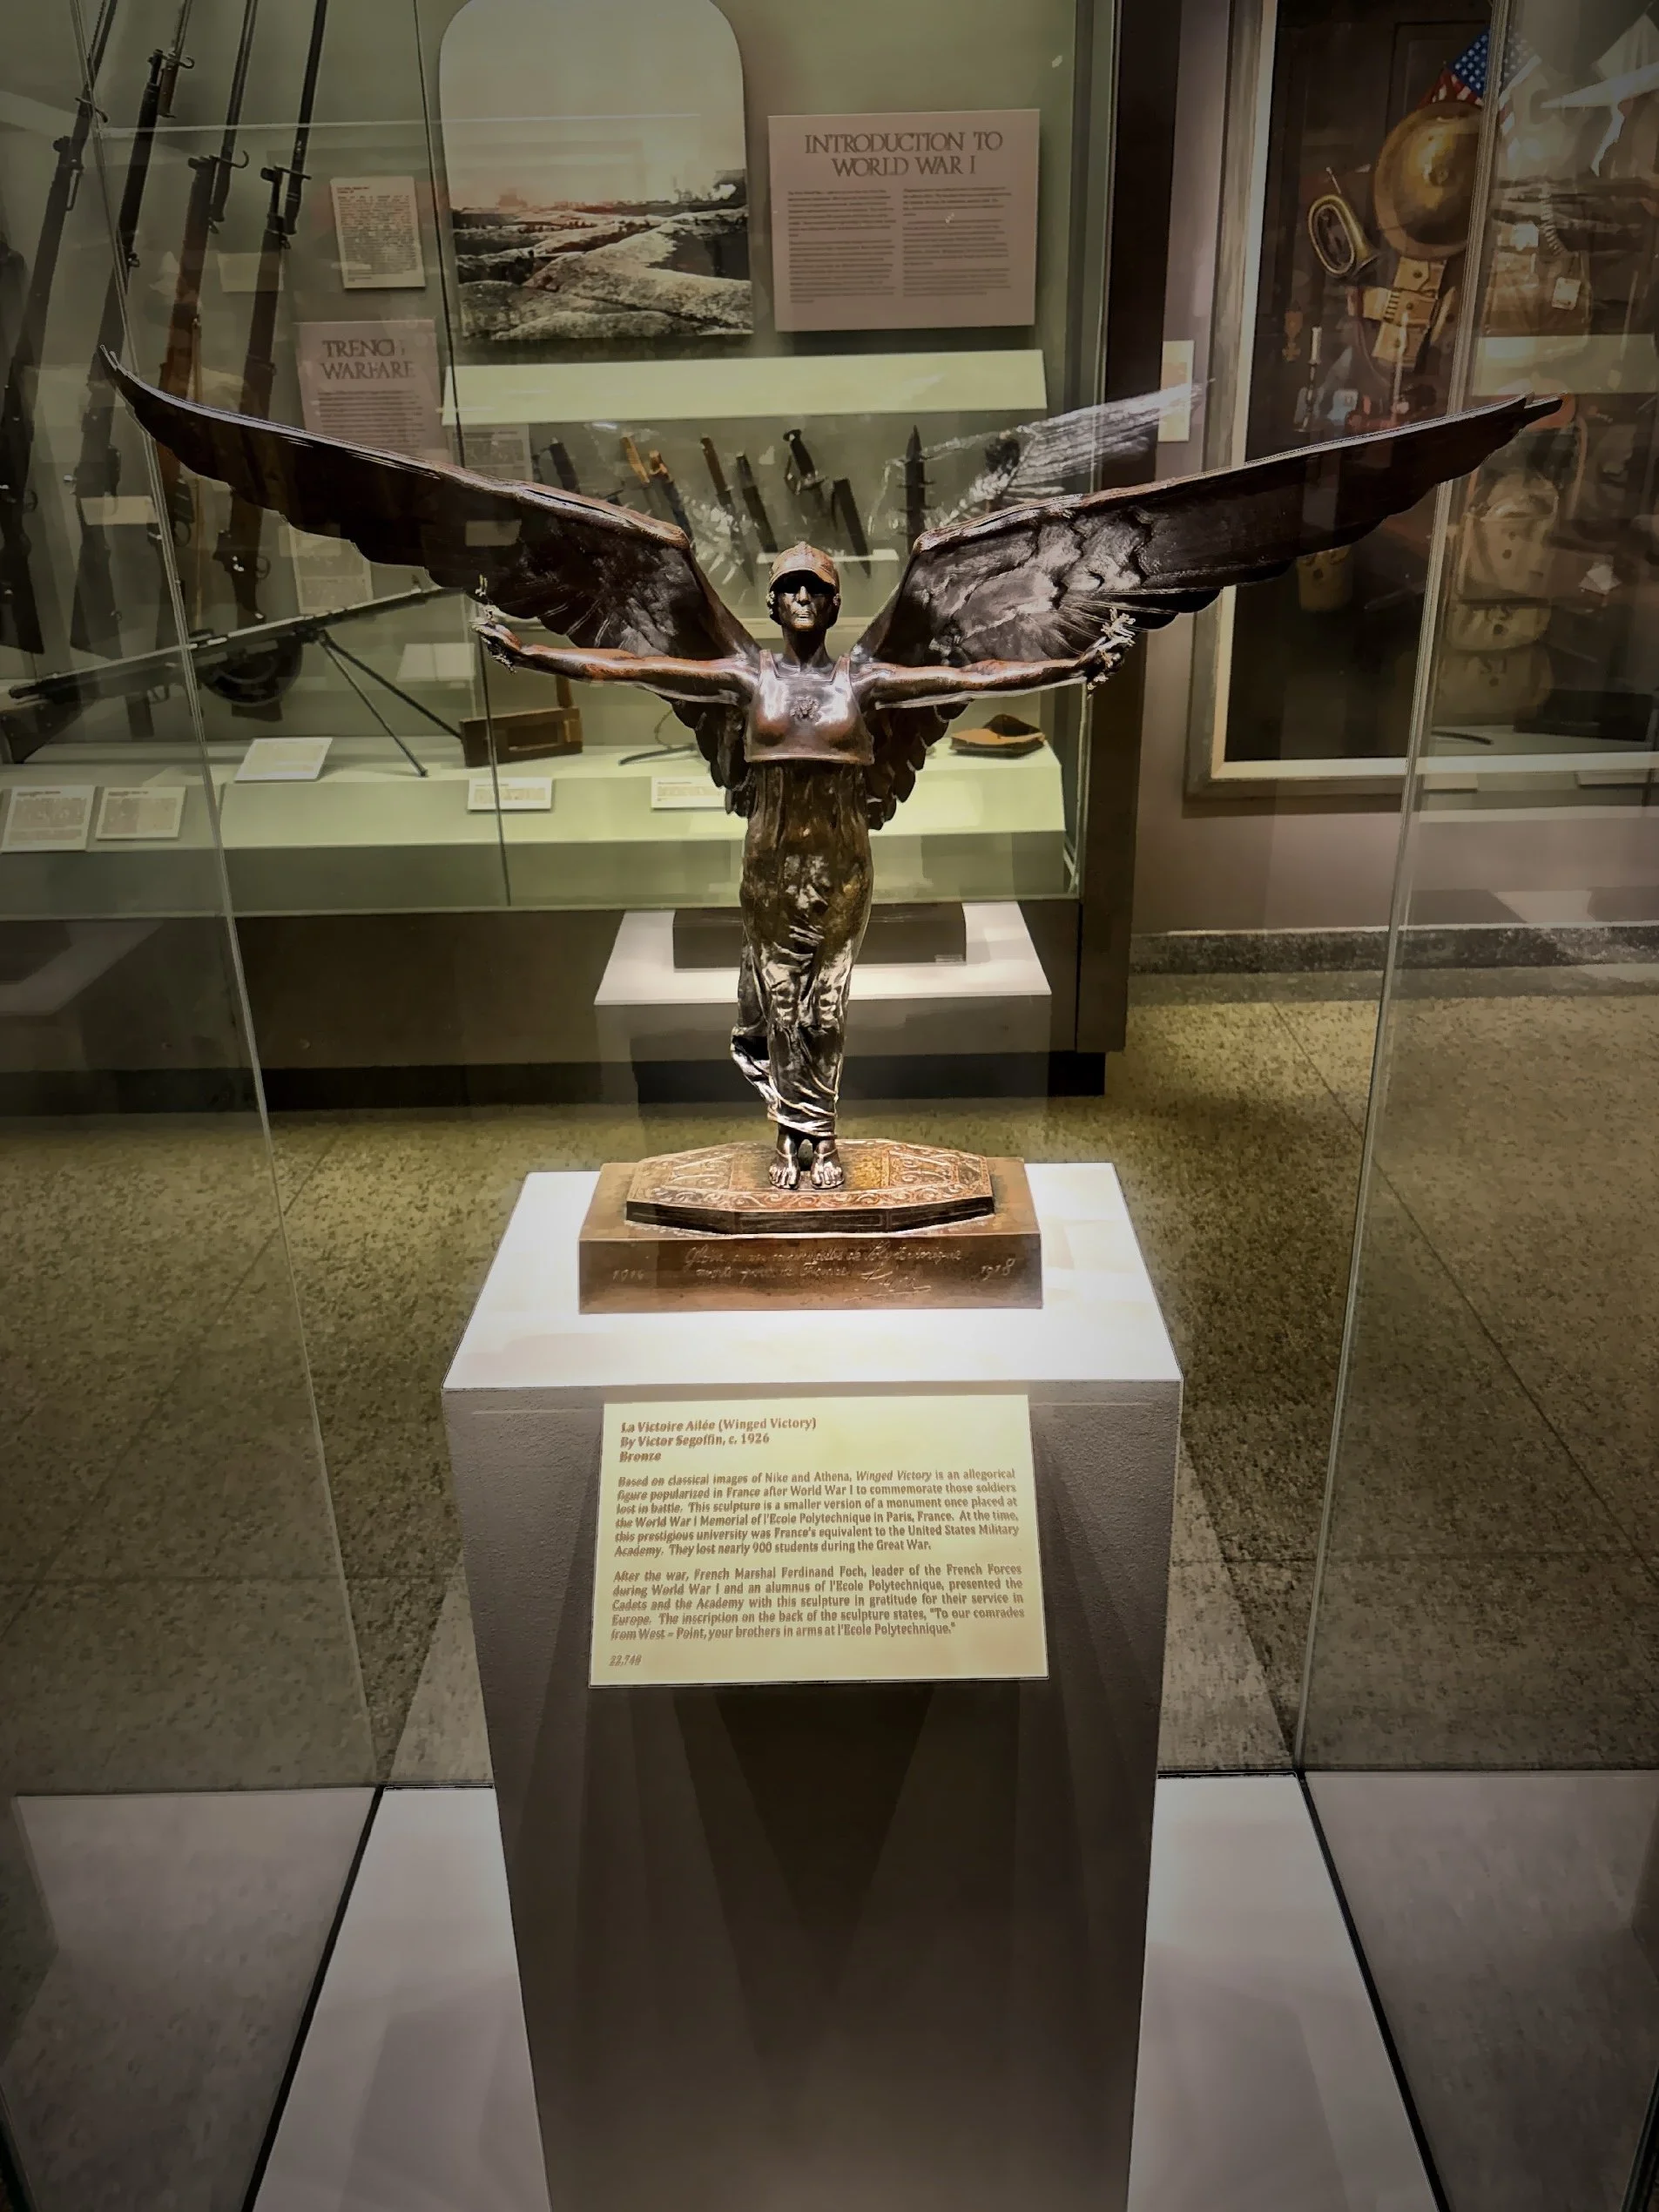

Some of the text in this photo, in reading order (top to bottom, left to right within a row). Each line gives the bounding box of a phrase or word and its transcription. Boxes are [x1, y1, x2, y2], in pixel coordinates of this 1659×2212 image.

[805, 131, 1003, 154] INTRODUCTION TO
[831, 155, 976, 177] WORLD WAR I
[320, 361, 416, 380] WARFARE
[620, 1421, 636, 1433] La
[637, 1420, 685, 1433] Victoire
[718, 1418, 767, 1432] (Winged
[769, 1417, 817, 1431] Victory)
[619, 1433, 770, 1449] By Victor Segoffin, c. 1926
[618, 1450, 662, 1462] Bronze
[617, 1467, 1015, 1487] Based on classical images of Nike and Athena, Winged Victory is an allegorical
[616, 1479, 1017, 1502] figure popularized in France after World War to commemorate those soldiers
[615, 1494, 1017, 1514] lost in battle. This sculpture is smaller version of monument once placed at
[614, 1516, 633, 1528] the
[634, 1515, 667, 1527] World
[668, 1515, 692, 1527] War
[699, 1514, 749, 1526] Memorial
[750, 1513, 762, 1525] of
[799, 1511, 872, 1526] Polytechnique
[873, 1511, 884, 1522] in
[885, 1510, 914, 1523] Paris,
[916, 1509, 954, 1521] France.
[958, 1509, 971, 1521] At
[972, 1507, 990, 1521] the
[991, 1510, 1018, 1521] time,
[614, 1523, 1020, 1543] this prestigious university was France's equivalent to the United States Military
[613, 1538, 932, 1559] Academy. They lost nearly 900 students during the Great War.
[613, 1562, 1022, 1582] After the war, French Marshal Ferdinand Foch, leader of the French Forces
[611, 1584, 648, 1599] during
[651, 1583, 685, 1595] World
[687, 1582, 711, 1595] War
[723, 1581, 744, 1595] and
[747, 1584, 761, 1594] an
[765, 1580, 811, 1594] alumnus
[813, 1580, 826, 1592] of
[867, 1577, 945, 1594] Polytechnique,
[948, 1577, 1001, 1592] presented
[1004, 1576, 1023, 1588] the
[610, 1591, 1024, 1612] Cadets and the Academy with this sculpture in gratitude for their service in
[610, 1614, 652, 1626] Europe.
[658, 1612, 679, 1625] The
[681, 1611, 738, 1627] inscription
[741, 1613, 755, 1622] on
[758, 1610, 776, 1622] the
[778, 1609, 803, 1622] back
[806, 1609, 818, 1622] of
[819, 1608, 838, 1621] the
[840, 1608, 890, 1623] sculpture
[892, 1608, 927, 1621] states,
[950, 1609, 971, 1618] our
[972, 1606, 1025, 1618] comrades
[610, 1628, 637, 1641] from
[637, 1628, 666, 1640] West
[676, 1626, 707, 1640] Point,
[708, 1629, 734, 1641] your
[735, 1624, 781, 1638] brothers
[782, 1625, 793, 1637] in
[795, 1626, 823, 1636] arms
[823, 1625, 835, 1635] at
